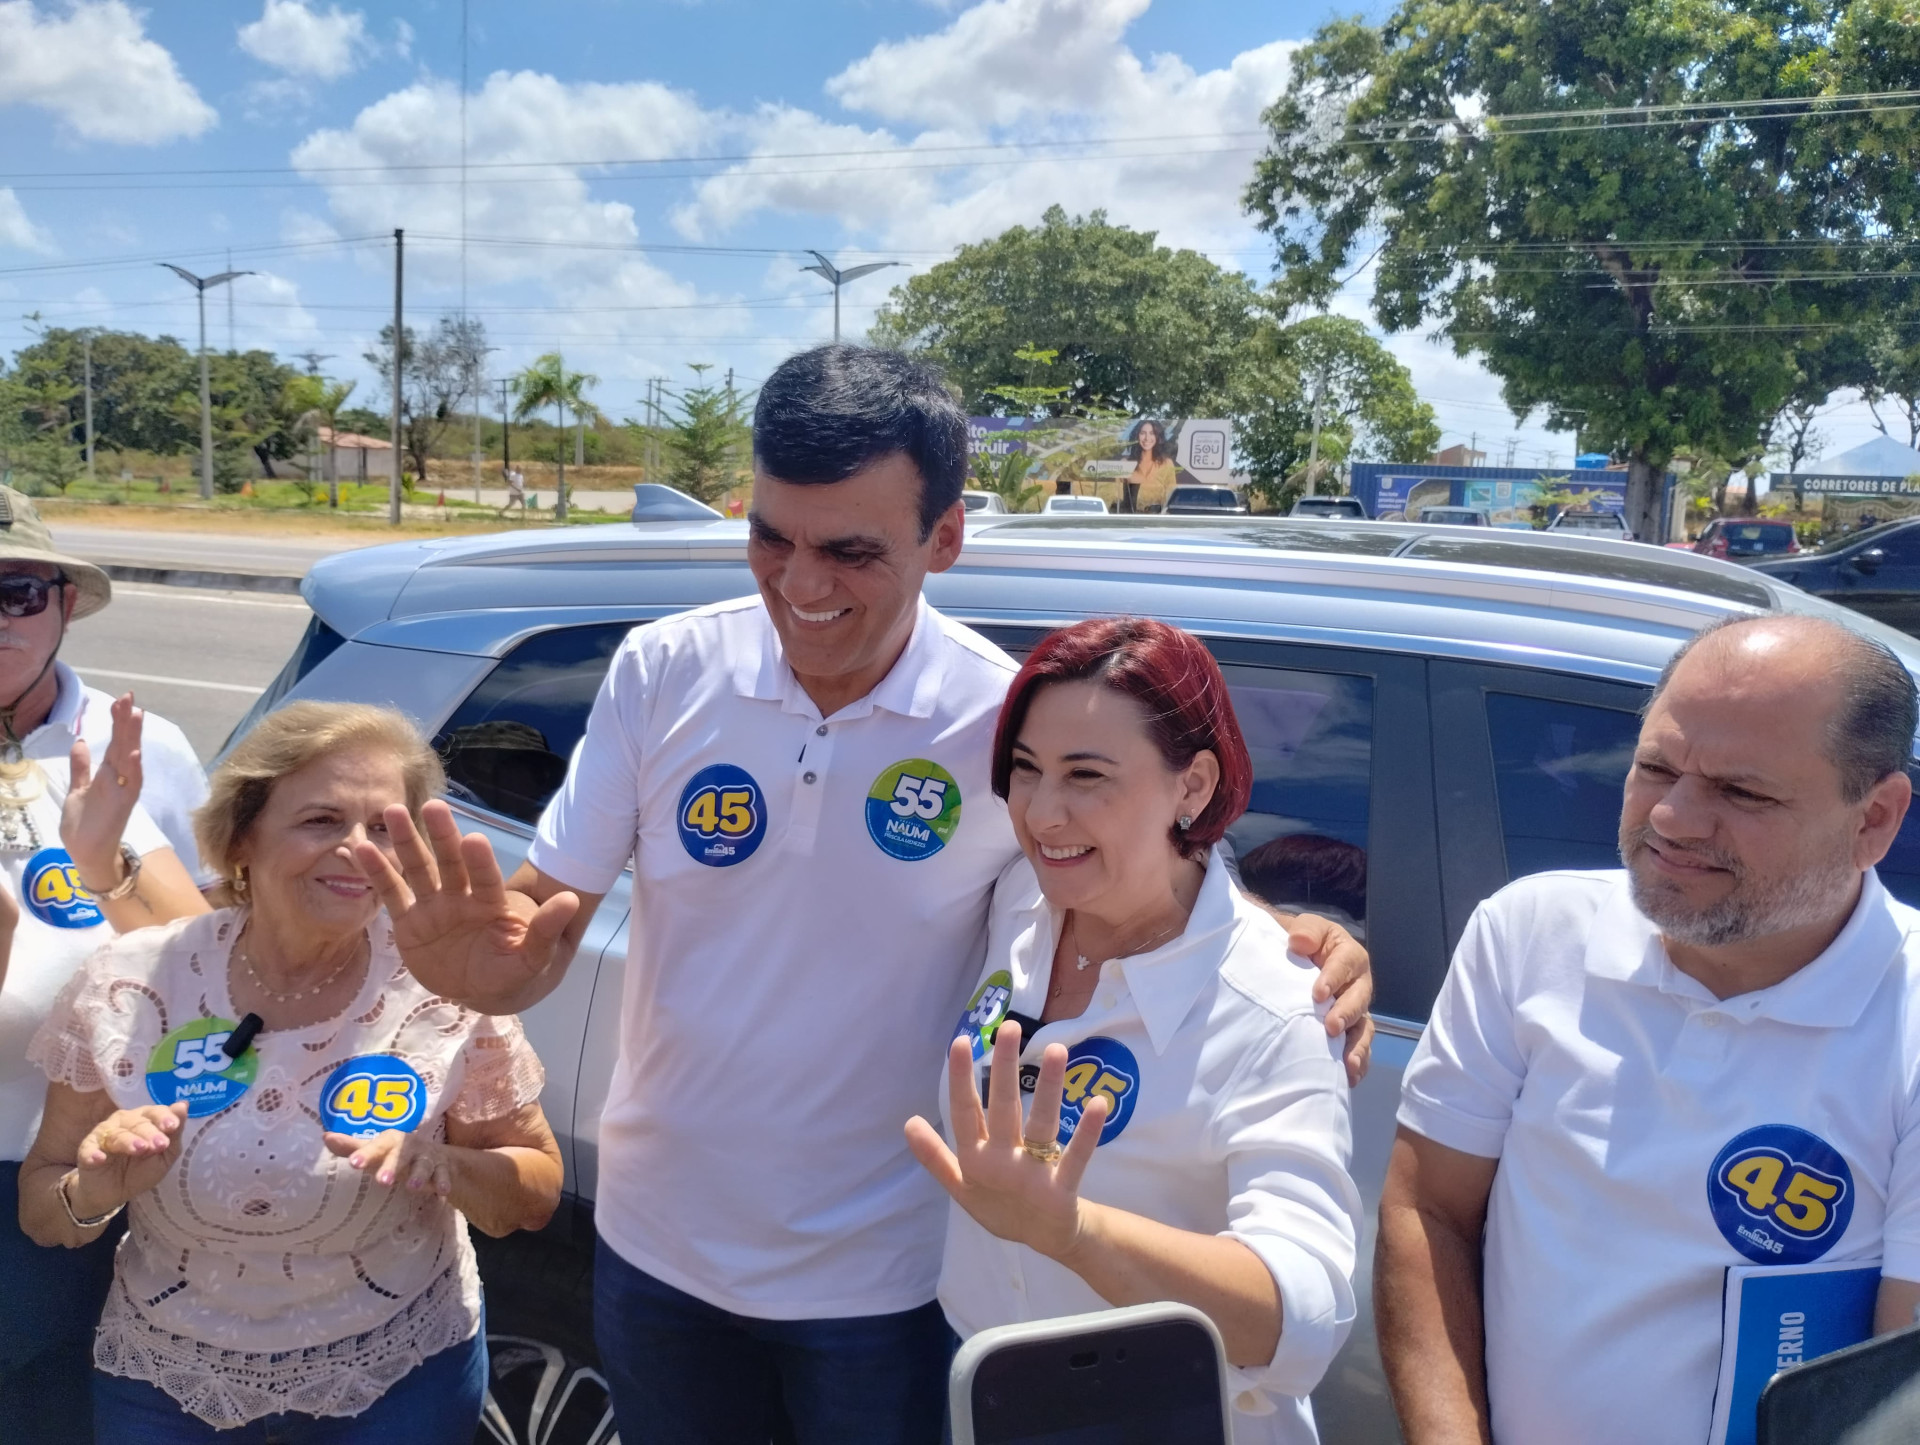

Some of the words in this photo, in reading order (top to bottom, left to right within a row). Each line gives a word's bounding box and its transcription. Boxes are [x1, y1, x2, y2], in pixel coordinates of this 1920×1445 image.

[966, 424, 988, 438] to
[1803, 478, 1879, 492] CORRETORES
[1881, 481, 1896, 493] DE
[687, 791, 752, 833] 45
[888, 774, 948, 820] 55
[885, 818, 931, 842] NAUMI
[968, 984, 1011, 1026] 55
[172, 1031, 235, 1080] 55
[175, 1079, 228, 1099] NAUMI
[332, 1078, 411, 1120] 45
[1063, 1062, 1127, 1118] 45
[1727, 1156, 1838, 1232] 45
[1776, 1312, 1805, 1372] ERNO
